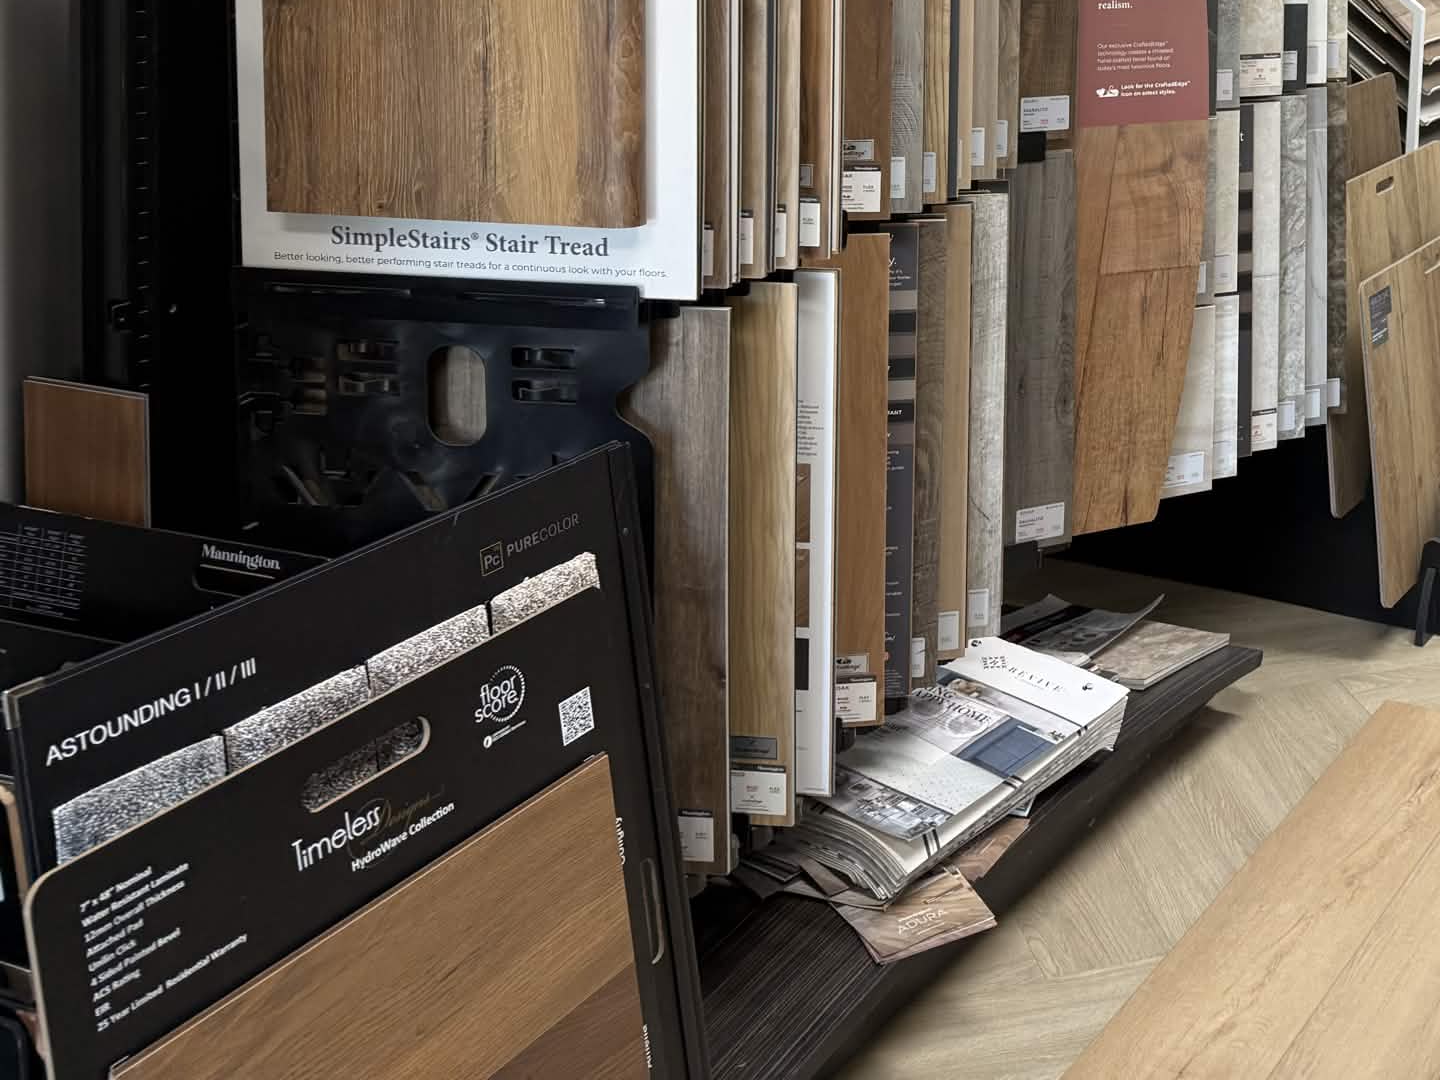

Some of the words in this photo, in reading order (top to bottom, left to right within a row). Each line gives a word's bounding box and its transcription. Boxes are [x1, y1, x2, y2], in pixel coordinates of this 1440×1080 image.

[1098, 1, 1133, 10] realism.
[485, 233, 538, 255] Stair
[544, 235, 609, 257] Tread
[274, 251, 304, 261] Better
[306, 253, 344, 264] looking,
[346, 255, 375, 264] better
[377, 256, 431, 269] performing
[433, 258, 454, 268] stair
[456, 260, 487, 270] treads
[489, 261, 502, 270] for
[512, 263, 566, 274] continuous
[568, 265, 589, 274] look
[591, 266, 613, 276] with
[615, 268, 637, 278] your
[639, 268, 668, 278] floors.
[506, 513, 579, 558] PURECOLOR
[202, 543, 281, 570] Mannington
[46, 687, 192, 767] ASTOUNDING
[194, 682, 201, 700] I
[204, 676, 212, 697] /
[215, 670, 227, 691] II
[230, 664, 238, 685] /
[241, 657, 257, 680] III
[291, 806, 381, 871] Timeless
[351, 831, 408, 871] HydroWave
[408, 802, 455, 836] Collection
[898, 908, 949, 935] ADURA
